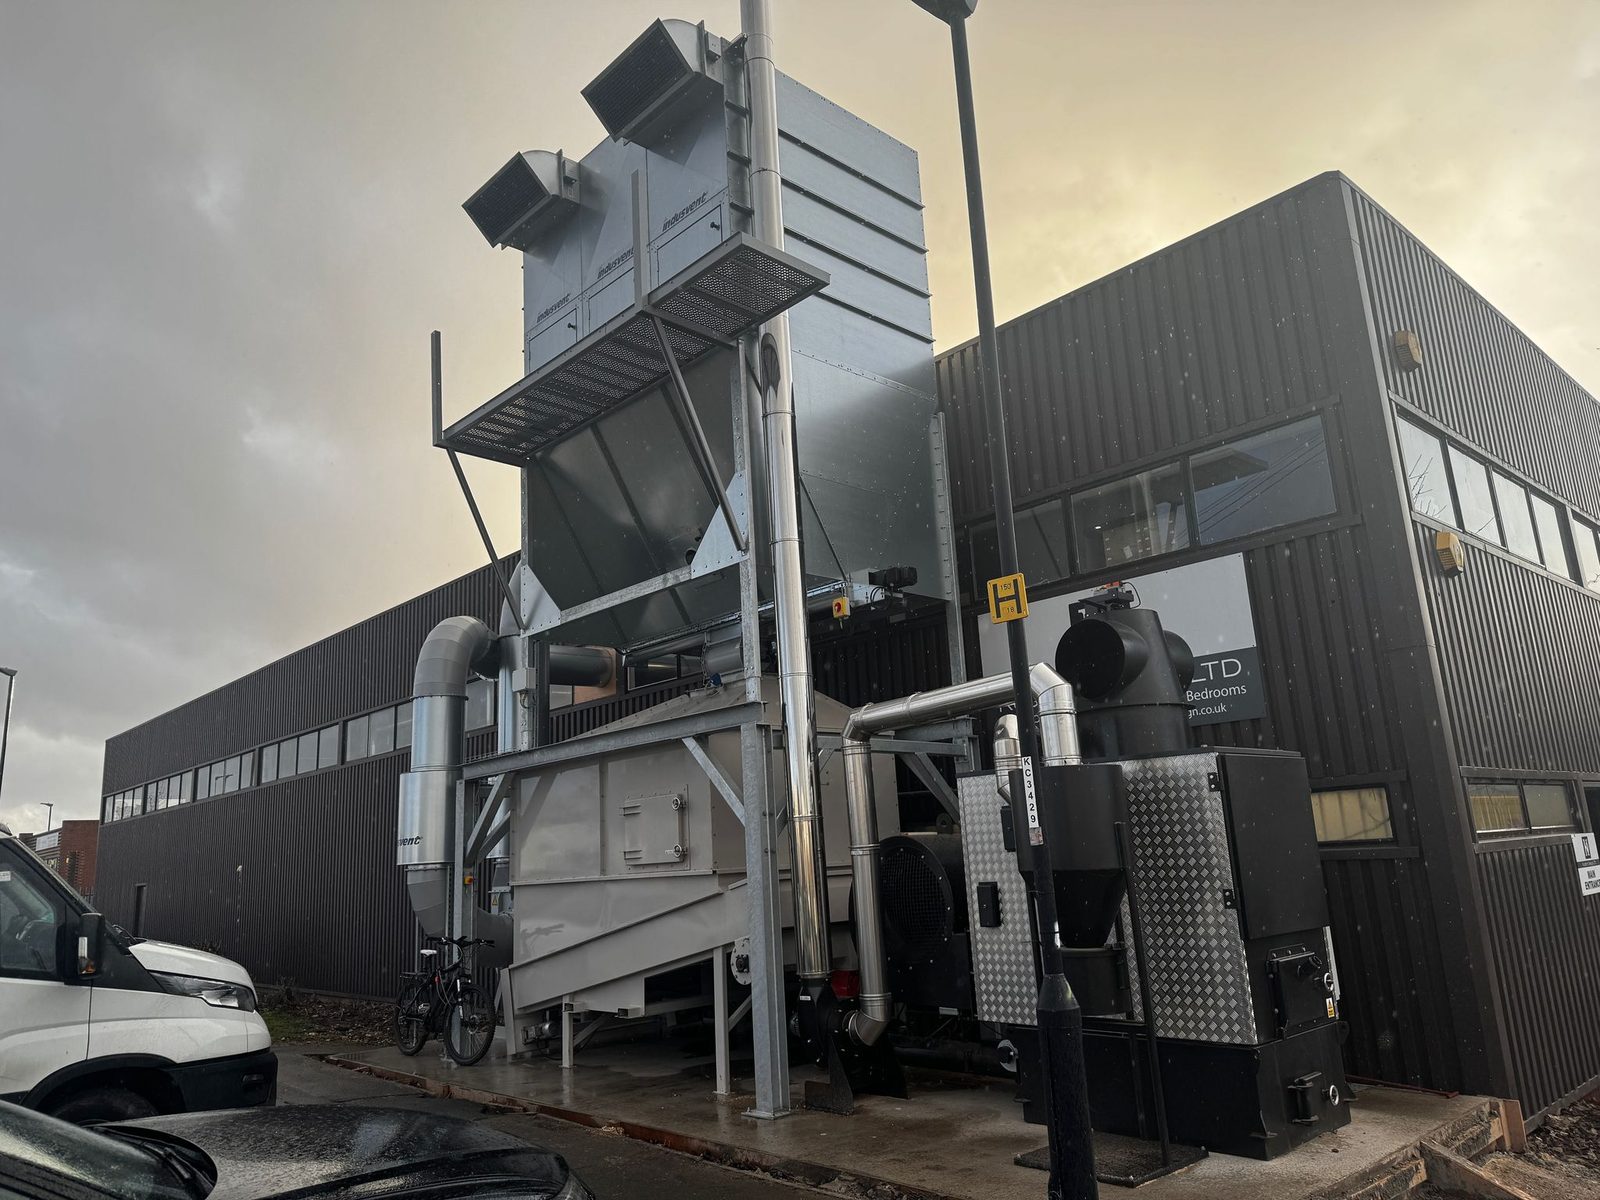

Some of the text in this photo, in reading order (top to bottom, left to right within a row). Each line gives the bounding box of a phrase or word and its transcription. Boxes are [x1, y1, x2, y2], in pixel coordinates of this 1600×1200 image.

[662, 191, 708, 232] indusvent
[537, 293, 570, 323] indusvent
[992, 578, 1022, 618] H
[1186, 685, 1247, 702] Bedrooms
[1023, 757, 1036, 823] KC3429
